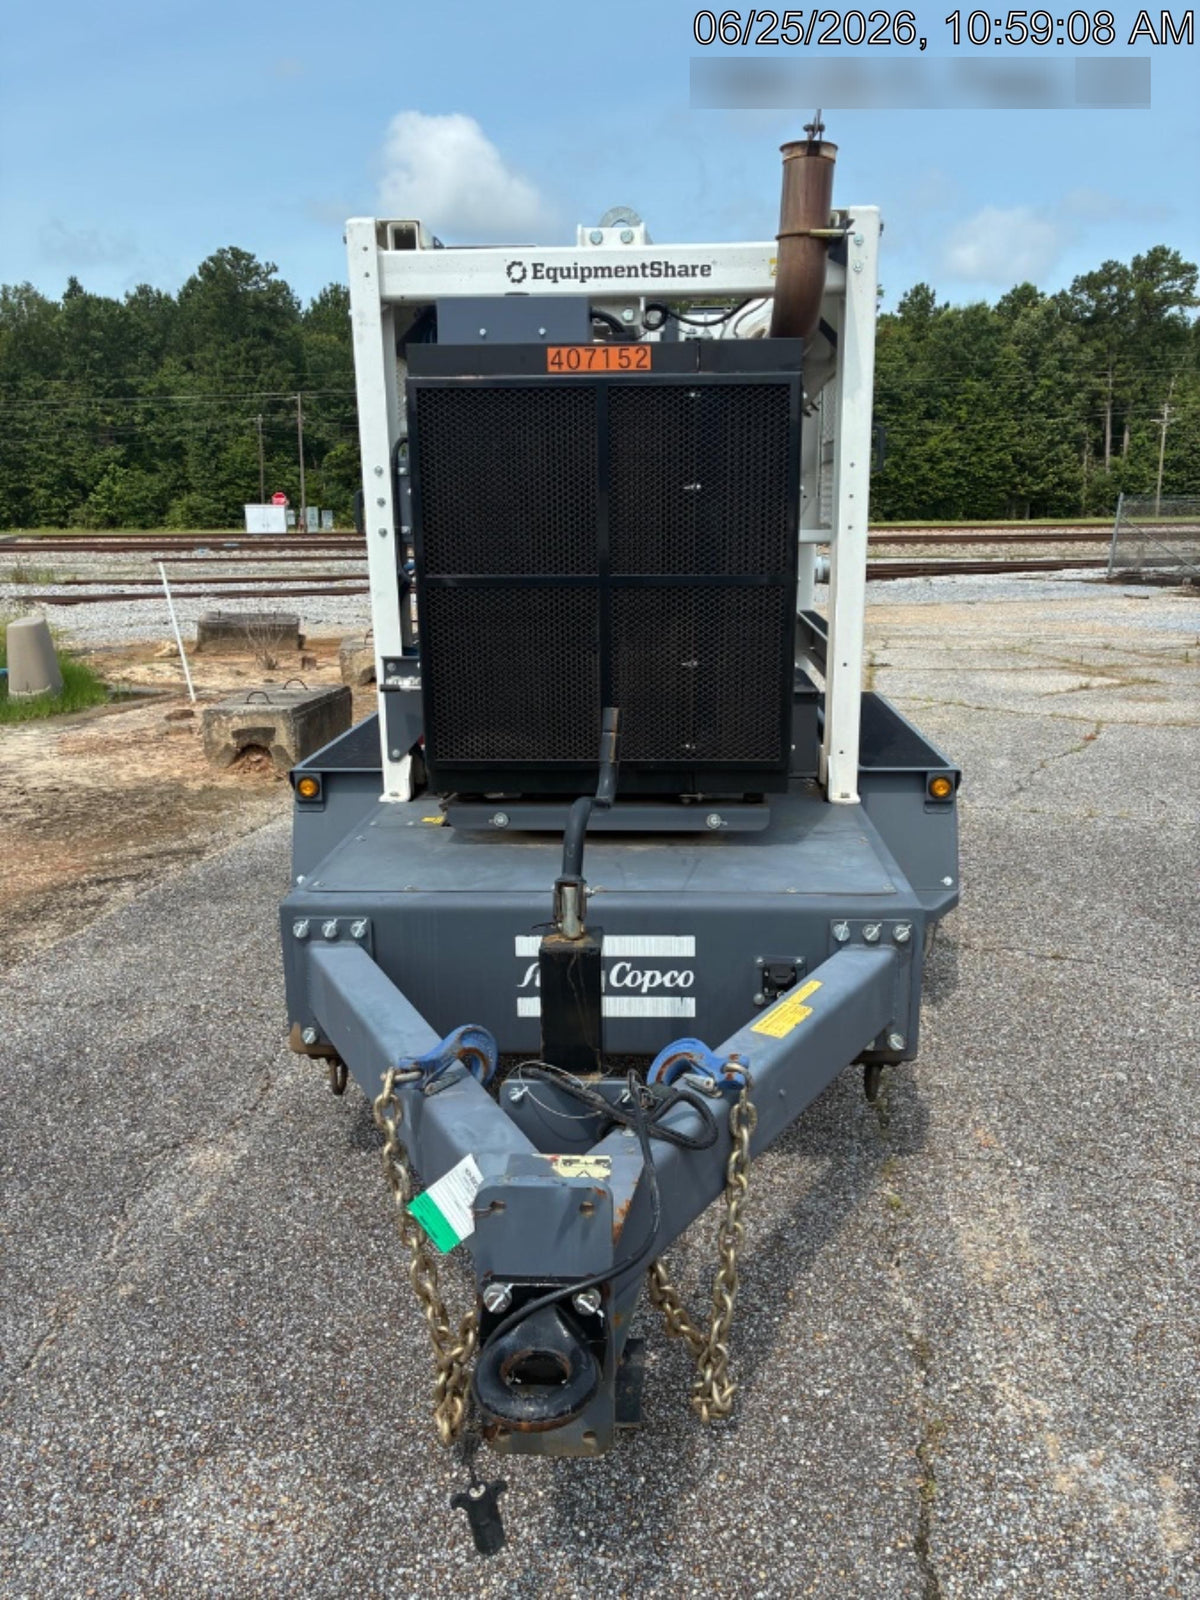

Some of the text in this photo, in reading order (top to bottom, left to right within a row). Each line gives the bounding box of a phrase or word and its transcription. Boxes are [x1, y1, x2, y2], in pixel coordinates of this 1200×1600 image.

[531, 261, 712, 283] EquipmentShare
[549, 348, 649, 370] 407152
[609, 962, 695, 993] Copco
